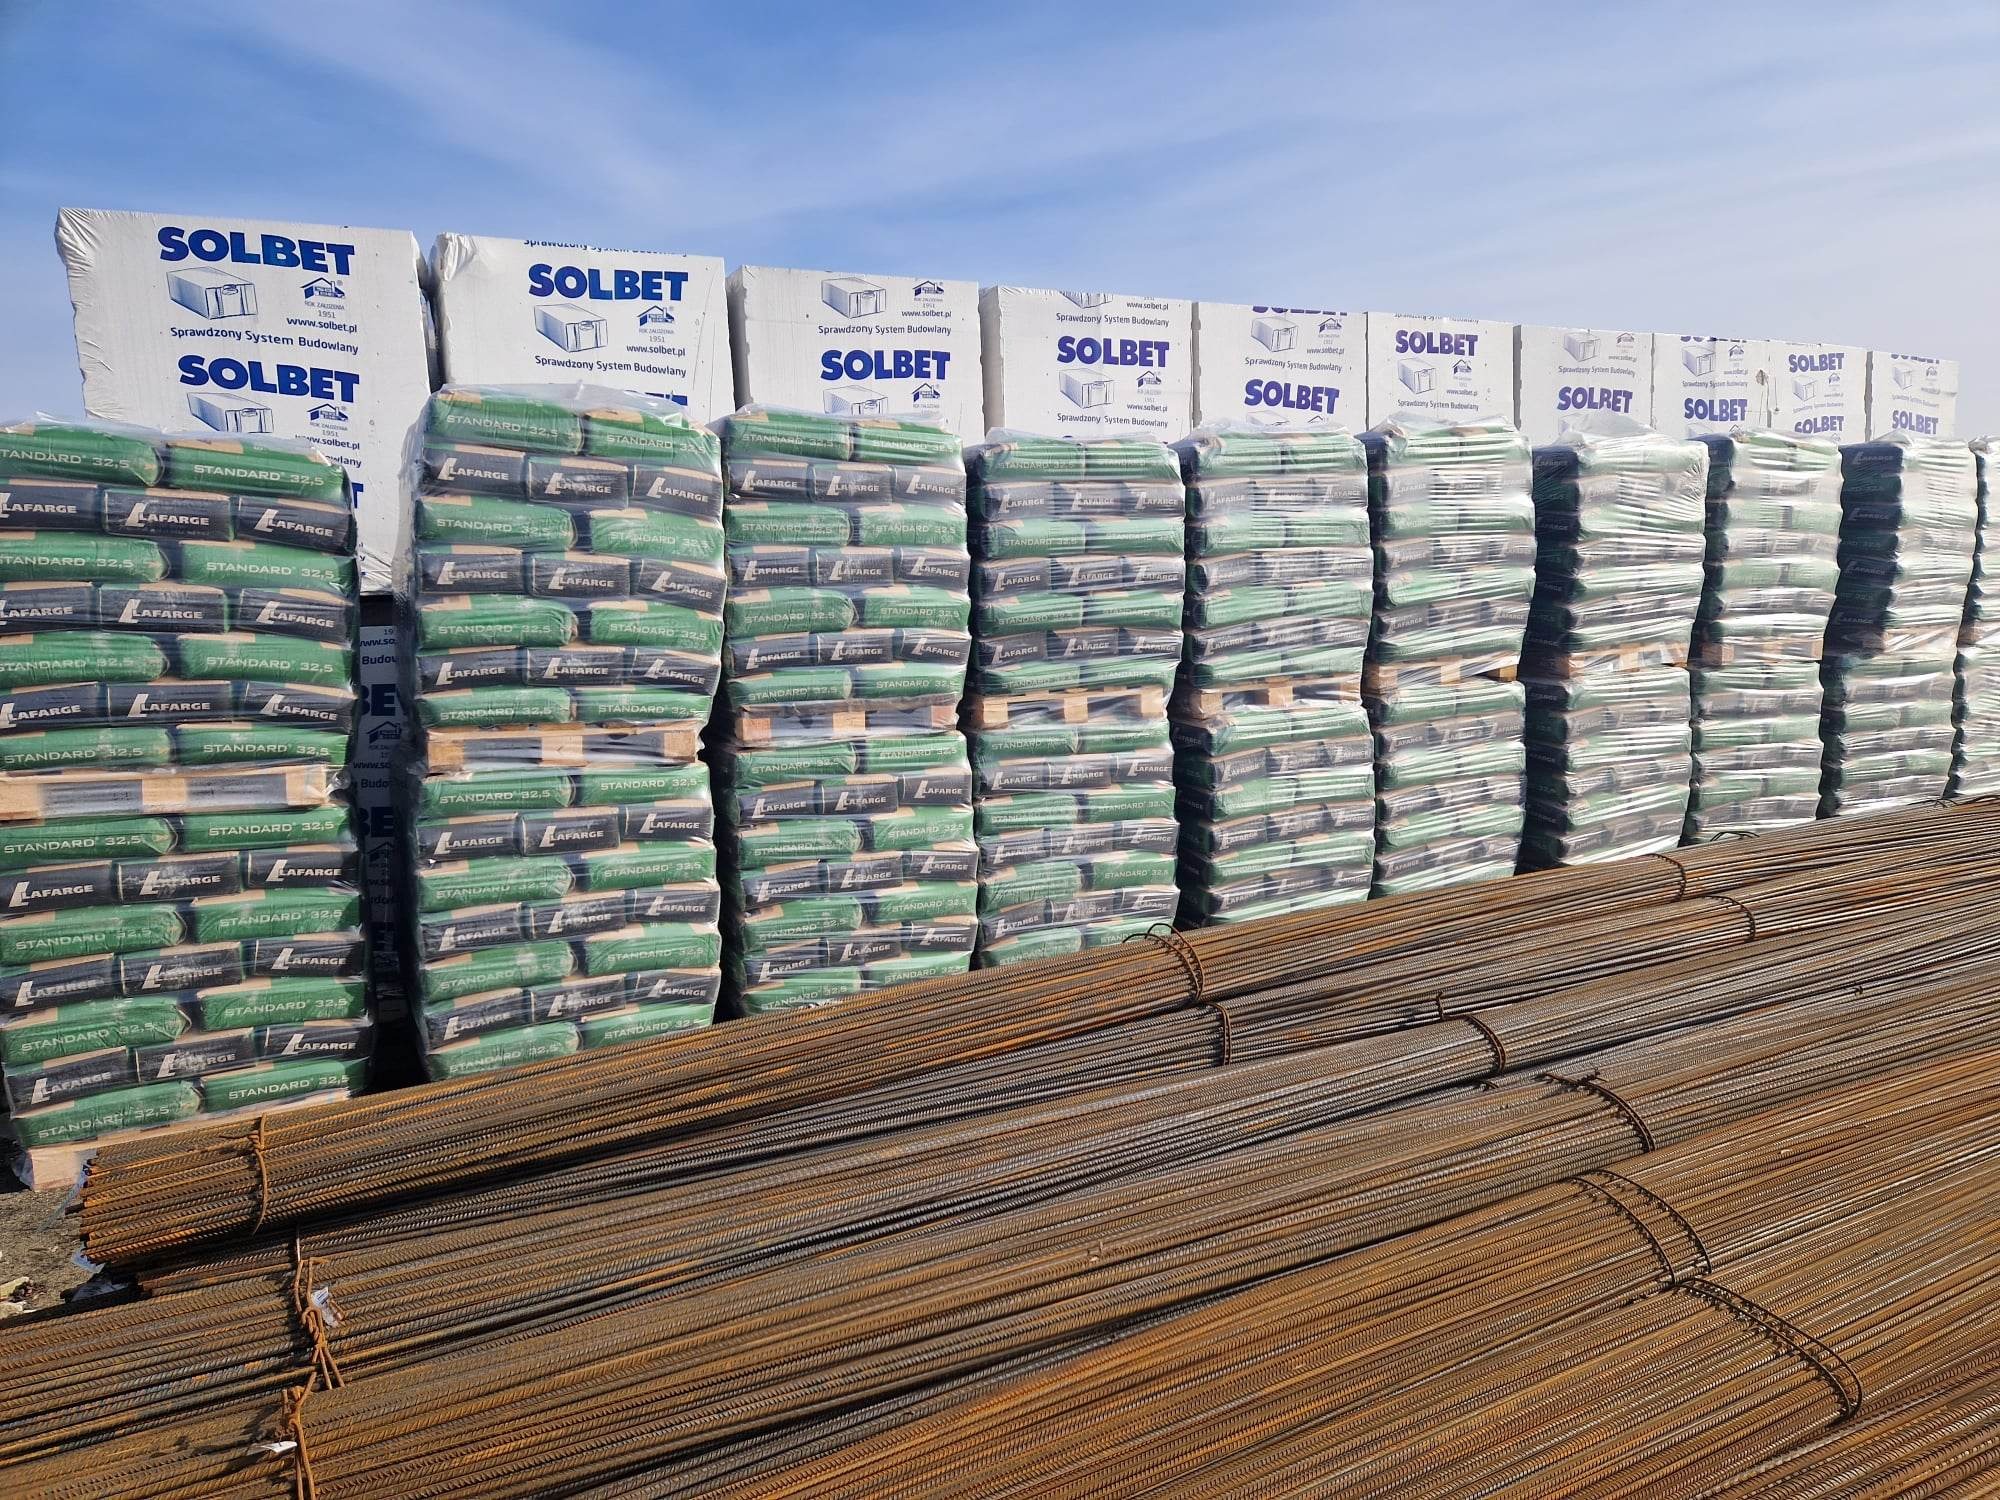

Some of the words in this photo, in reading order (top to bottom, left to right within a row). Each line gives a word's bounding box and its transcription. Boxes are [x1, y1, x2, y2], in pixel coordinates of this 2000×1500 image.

[158, 227, 355, 275] SOLBET
[528, 263, 688, 300] SOLBET
[318, 310, 336, 318] 1951
[901, 309, 952, 319] www.solbet.pl
[1126, 301, 1169, 310] www.solbet.pl
[287, 317, 357, 333] www.solbet.pl
[818, 324, 873, 335] Sprawdzony
[876, 325, 905, 335] System
[907, 325, 952, 336] Budowlany
[1056, 313, 1101, 323] Sprawdzony
[1104, 315, 1130, 324] System
[1132, 317, 1169, 327] Budowlany
[170, 327, 242, 340] Sprawdzony
[245, 330, 293, 345] System
[298, 337, 358, 355] Budowlany
[626, 344, 686, 357] www.solbet.pl
[1395, 330, 1478, 356] SOLBET
[1057, 336, 1169, 368] SOLBET
[535, 355, 594, 371] Sprawdzony
[596, 360, 632, 373] System
[634, 362, 687, 378] Budowlany
[820, 350, 951, 381] SOLBET
[1245, 357, 1285, 369] Sprawdzony
[1287, 361, 1307, 370] System
[1309, 362, 1342, 373] Budowlany
[1788, 353, 1845, 373] SOLBET
[178, 355, 359, 403] SOLBET
[1245, 379, 1339, 414] SOLBET
[1684, 398, 1748, 421] SOLBET
[447, 415, 521, 432] STANDARD
[1057, 413, 1100, 424] Sprawdzony
[1104, 415, 1129, 425] System
[1132, 417, 1168, 428] Budowlany
[1893, 410, 1939, 435] SOLBET
[607, 435, 673, 448] STANDARD
[92, 458, 130, 468] 32,5
[437, 458, 510, 481] LAFARGE
[194, 465, 280, 481] STANDARD
[290, 474, 324, 486] 32,5
[740, 470, 797, 491] LAFARGE
[906, 474, 956, 494] LAFARGE
[646, 477, 708, 503] LAFARGE
[125, 502, 210, 528] LAFARGE
[254, 509, 334, 537] LAFARGE
[437, 518, 512, 532] STANDARD
[741, 524, 800, 532] STANDARD
[96, 559, 134, 568] 32,5
[206, 562, 292, 575] STANDARD
[302, 568, 335, 580] 32,5
[437, 561, 508, 585] LAFARGE
[829, 560, 882, 580] LAFARGE
[910, 556, 960, 578] LAFARGE
[548, 568, 615, 589] LAFARGE
[651, 571, 713, 599] LAFARGE
[993, 572, 1040, 592] LAFARGE
[118, 599, 203, 623] LAFARGE
[256, 601, 335, 628] LAFARGE
[880, 607, 934, 616] STANDARD
[438, 624, 513, 635] STANDARD
[609, 623, 675, 636] STANDARD
[830, 641, 883, 660] LAFARGE
[912, 637, 960, 658] LAFARGE
[993, 645, 1038, 664] LAFARGE
[206, 656, 290, 669] STANDARD
[300, 663, 333, 673] 32,5
[543, 658, 608, 679] LAFARGE
[746, 648, 800, 670] LAFARGE
[436, 662, 506, 686] LAFARGE
[644, 659, 705, 684] LAFARGE
[876, 680, 929, 688] STANDARD
[0, 703, 81, 728] LAFARGE
[128, 694, 210, 718] LAFARGE
[260, 694, 337, 721] LAFARGE
[440, 708, 514, 720] STANDARD
[598, 704, 665, 713] STANDARD
[4, 749, 96, 764] STANDARD
[204, 745, 287, 753] STANDARD
[297, 745, 329, 756] 32,5
[600, 780, 665, 791] STANDARD
[672, 778, 697, 787] 32,5
[914, 780, 962, 798] LAFARGE
[992, 772, 1037, 790] LAFARGE
[440, 792, 513, 804] STANDARD
[521, 790, 550, 799] 32,5
[752, 798, 806, 819] LAFARGE
[209, 824, 292, 836] STANDARD
[302, 822, 335, 831] 32,5
[639, 813, 700, 834] LAFARGE
[887, 826, 939, 838] STANDARD
[5, 838, 96, 853] STANDARD
[105, 836, 142, 846] 32,5
[434, 832, 504, 855] LAFARGE
[539, 826, 604, 848] LAFARGE
[266, 859, 342, 882] LAFARGE
[604, 864, 669, 877] STANDARD
[9, 881, 94, 907] LAFARGE
[646, 896, 705, 916] LAFARGE
[220, 912, 301, 927] STANDARD
[311, 910, 342, 919] 32,5
[16, 933, 105, 950] STANDARD
[271, 948, 347, 970] LAFARGE
[608, 950, 672, 962] STANDARD
[440, 970, 515, 990] STANDARD
[649, 979, 707, 997] LAFARGE
[224, 1001, 307, 1016] STANDARD
[316, 999, 348, 1008] 32,5
[22, 1029, 109, 1052] STANDARD
[605, 1022, 669, 1039] STANDARD
[281, 1034, 356, 1055] LAFARGE
[229, 1080, 309, 1100] STANDARD
[319, 1076, 350, 1086] 32,5
[135, 1107, 169, 1119] 32,5
